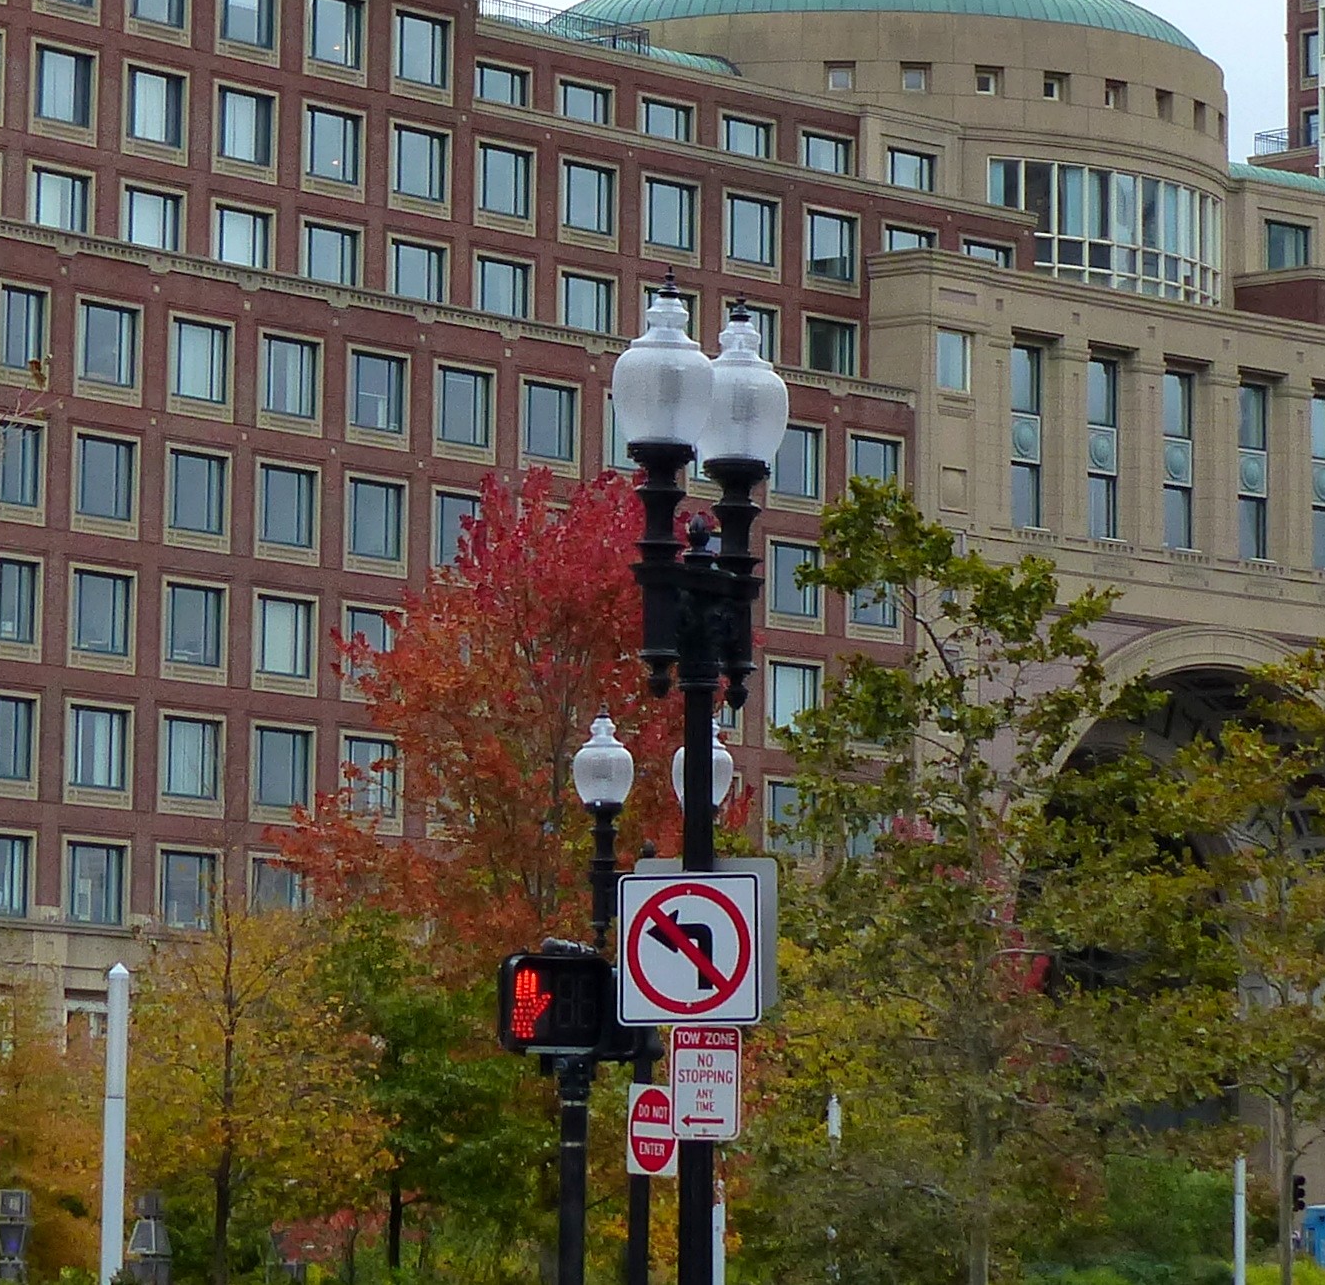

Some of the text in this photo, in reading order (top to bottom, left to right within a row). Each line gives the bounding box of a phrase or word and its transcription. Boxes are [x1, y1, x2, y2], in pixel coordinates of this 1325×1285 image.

[676, 1031, 736, 1045] TOW ZONE
[697, 1053, 714, 1067] NO
[677, 1069, 733, 1084] STOPPING
[696, 1089, 713, 1099] ANY
[638, 1103, 669, 1120] DO NOT
[695, 1101, 715, 1112] TIME
[639, 1142, 665, 1156] ENTER
